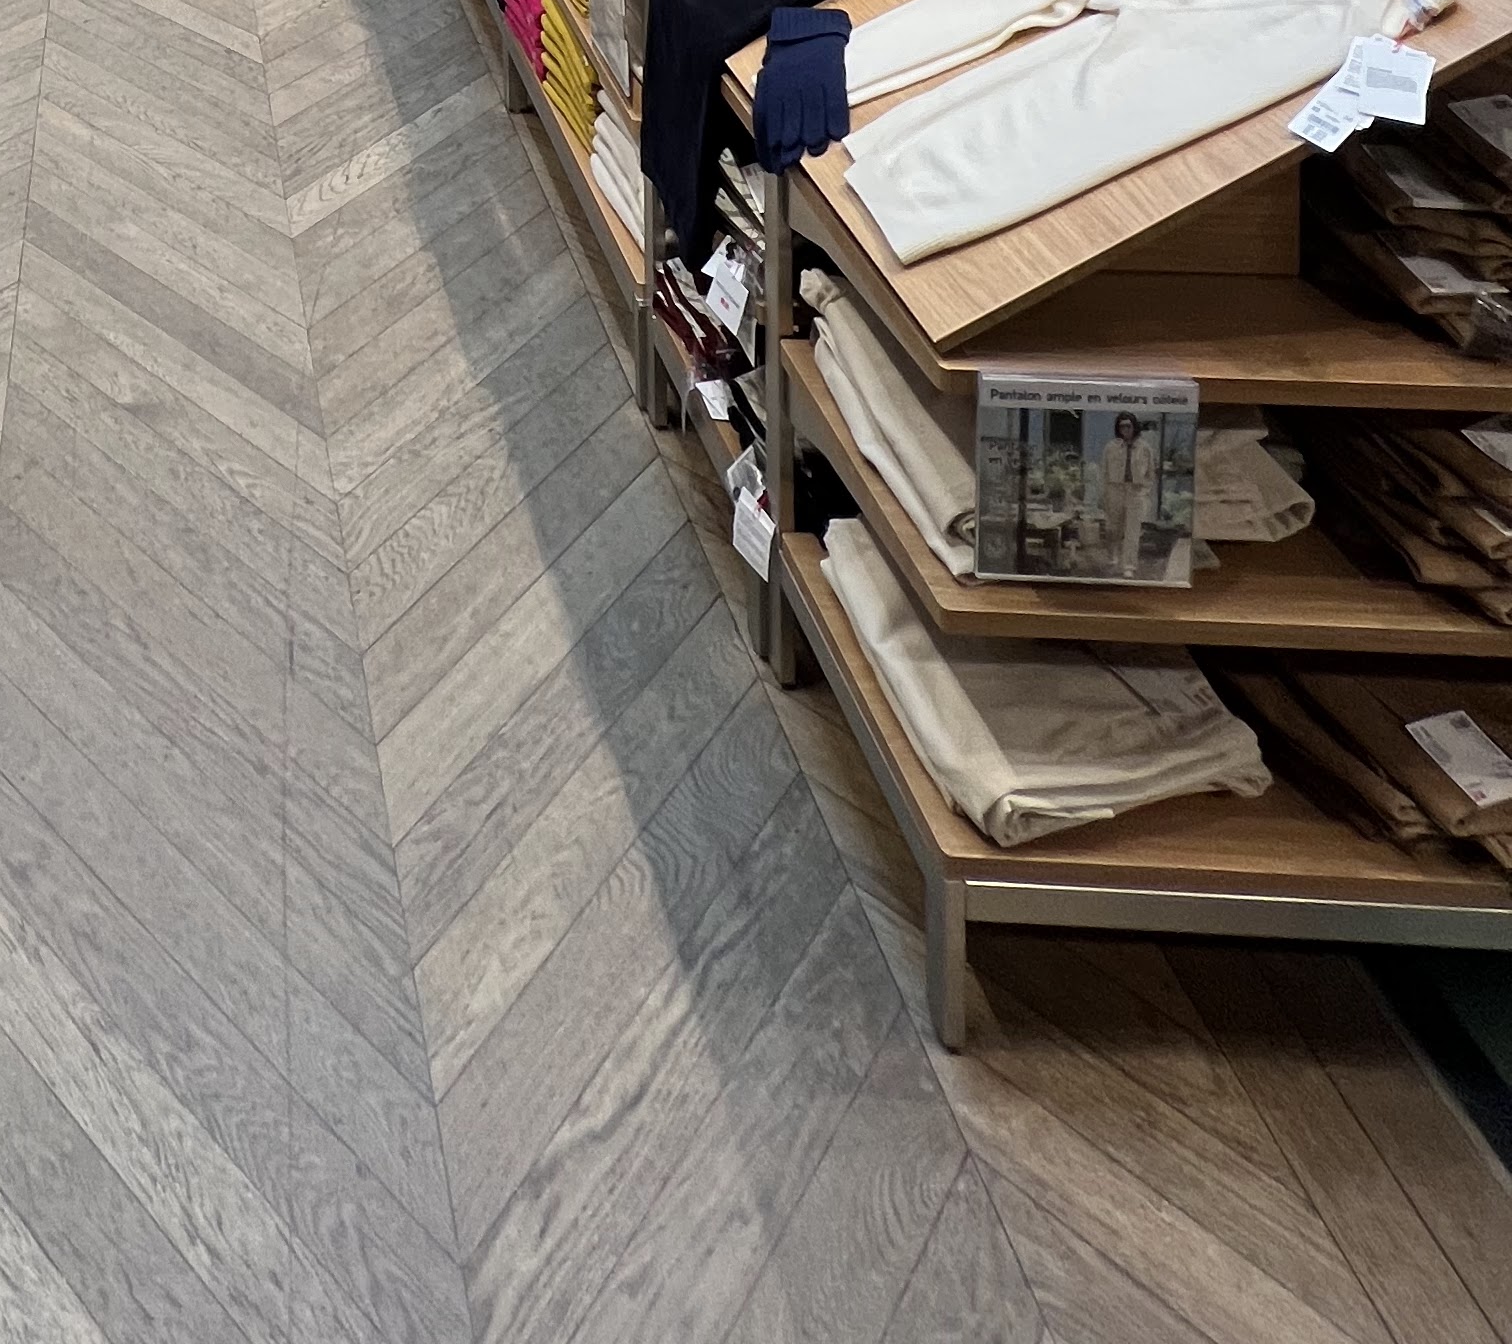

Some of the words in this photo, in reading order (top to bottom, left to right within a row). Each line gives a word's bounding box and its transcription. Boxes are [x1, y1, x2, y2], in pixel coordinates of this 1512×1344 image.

[990, 388, 1042, 402] Pantalon
[1046, 391, 1083, 404] ample
[1087, 394, 1102, 404] en
[1106, 393, 1148, 405] velours
